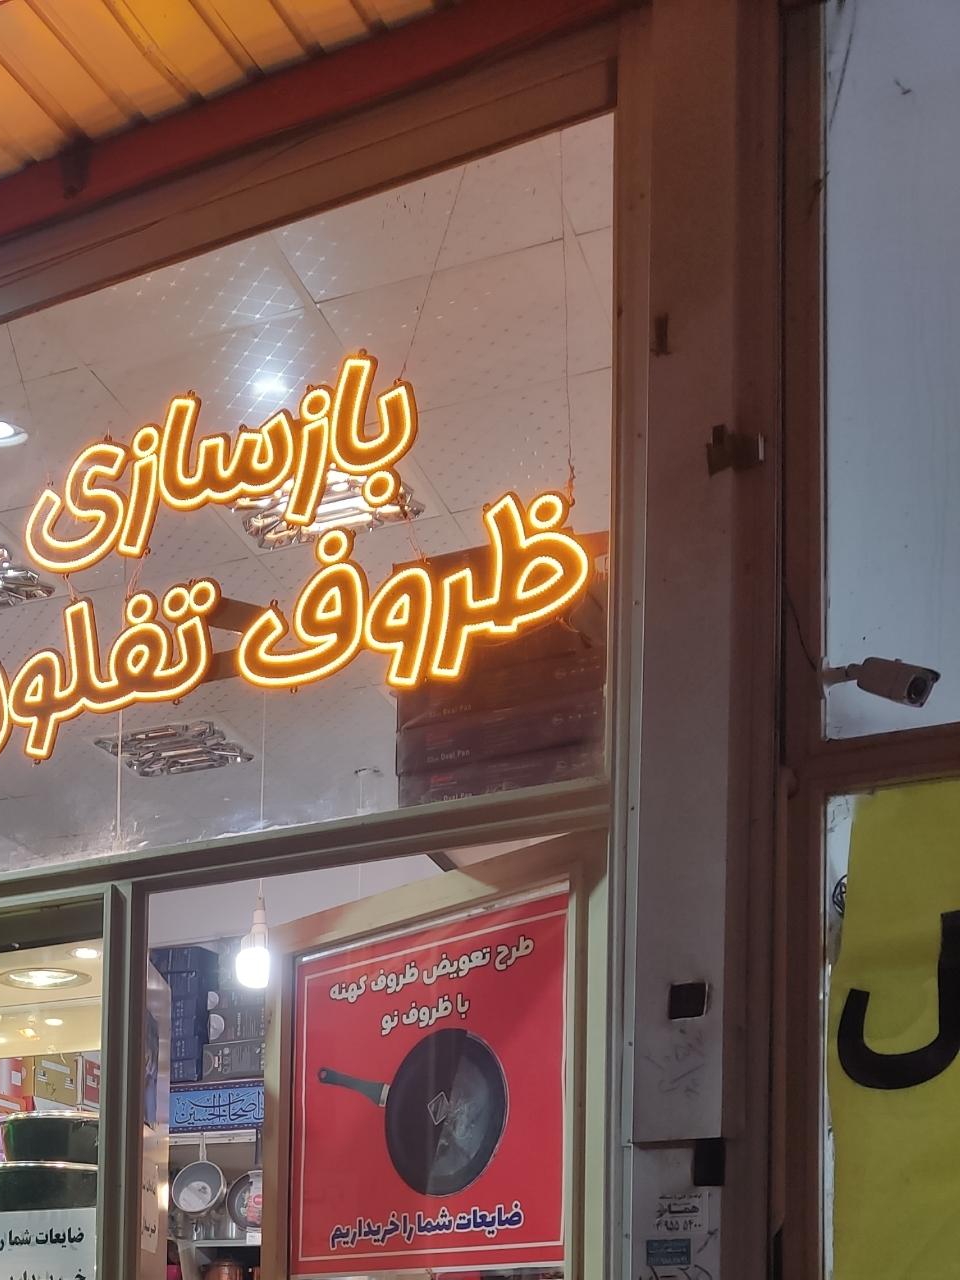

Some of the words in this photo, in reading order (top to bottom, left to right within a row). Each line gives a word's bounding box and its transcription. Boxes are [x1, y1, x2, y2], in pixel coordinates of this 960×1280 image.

[237, 491, 591, 689] ظروف
[422, 947, 490, 985] تعویض
[494, 935, 535, 970] طرح
[329, 975, 368, 1003] کهنه
[370, 961, 419, 993] ظروف
[402, 994, 453, 1028] ظروف
[456, 993, 470, 1018] با
[380, 1010, 399, 1036] نو
[330, 1211, 401, 1249] خریداریم
[401, 1213, 415, 1244] را
[416, 1207, 453, 1236] شما
[455, 1200, 525, 1239] ضایعات
[8, 1229, 32, 1247] شما
[35, 1226, 85, 1249] ضایعات
